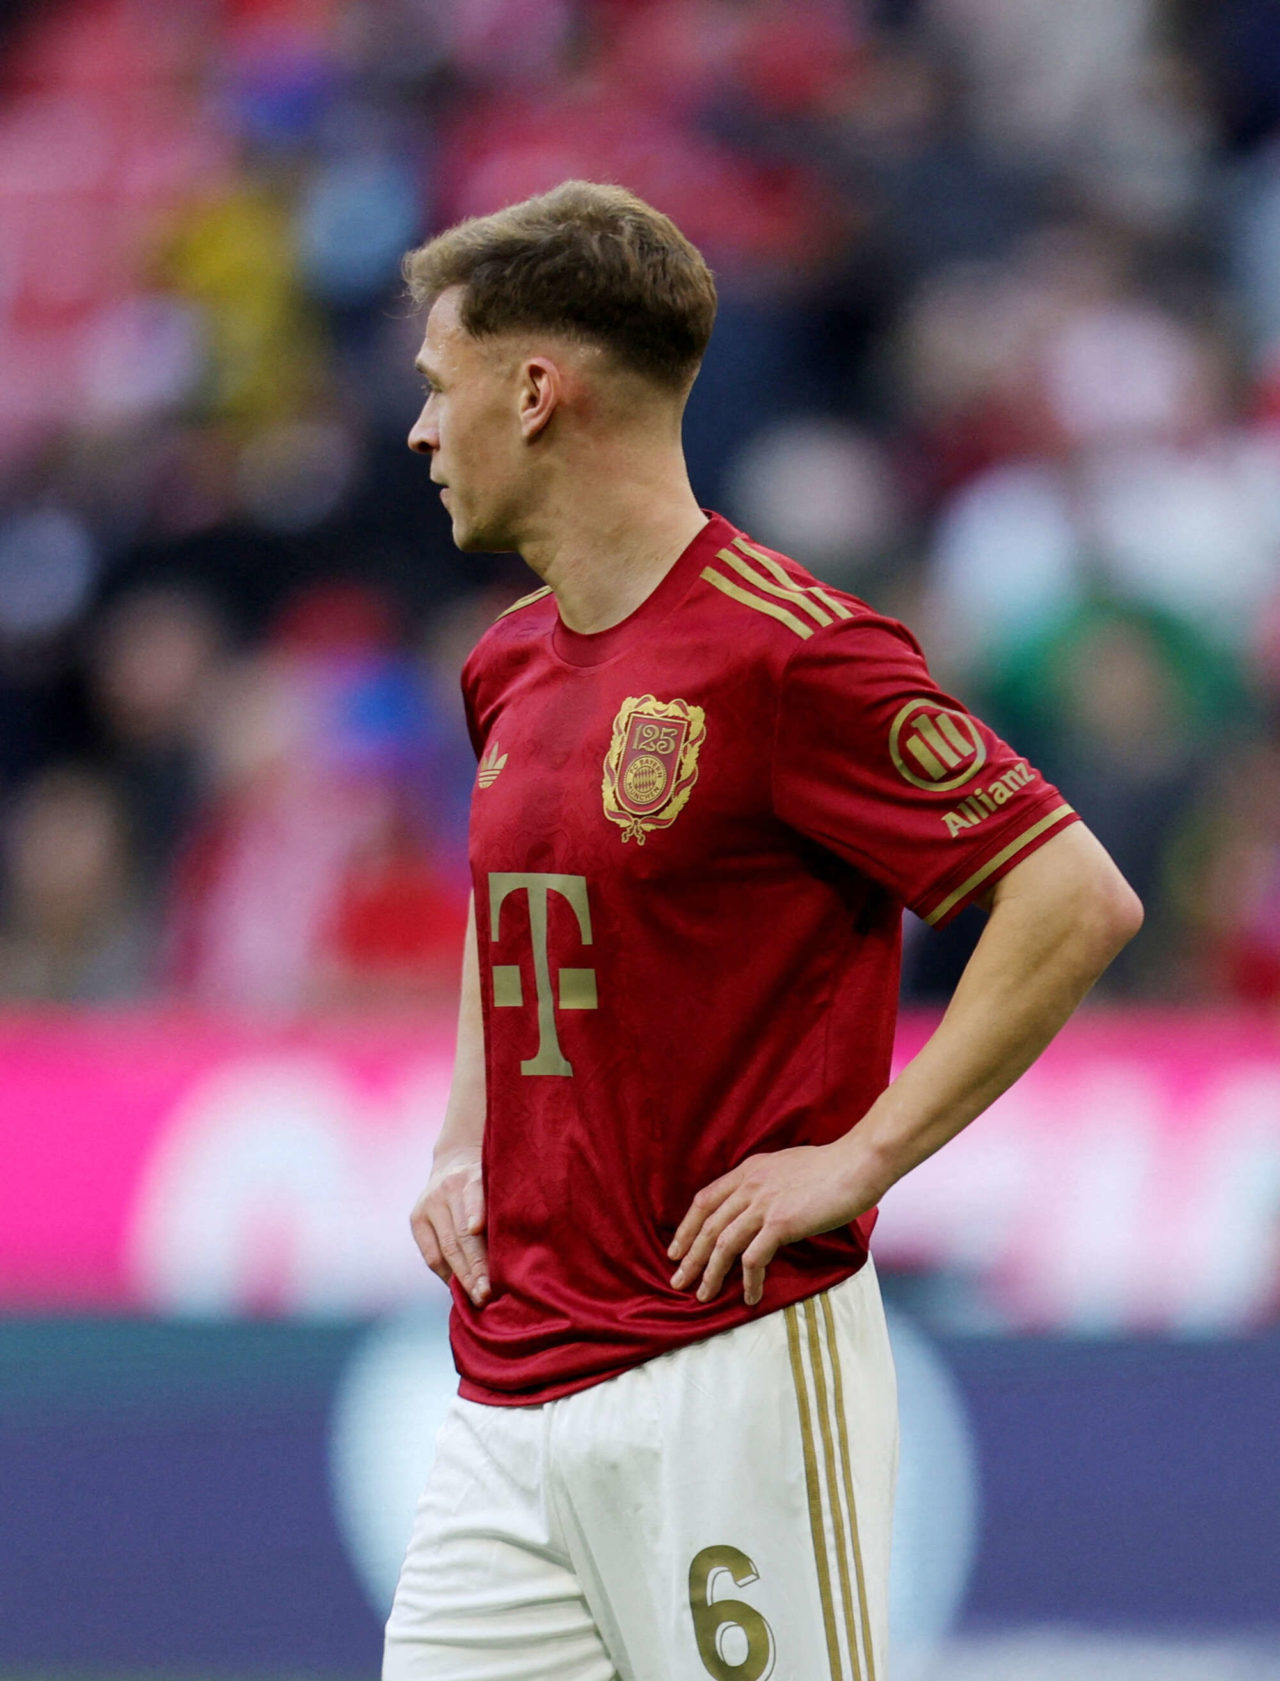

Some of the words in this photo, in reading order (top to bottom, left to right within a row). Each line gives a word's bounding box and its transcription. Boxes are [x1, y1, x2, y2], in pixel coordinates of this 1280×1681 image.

[632, 724, 678, 754] 125
[640, 758, 663, 778] BAYERN
[941, 762, 1036, 838] Allianz
[488, 872, 598, 1077] T
[688, 1544, 776, 1681] 6
